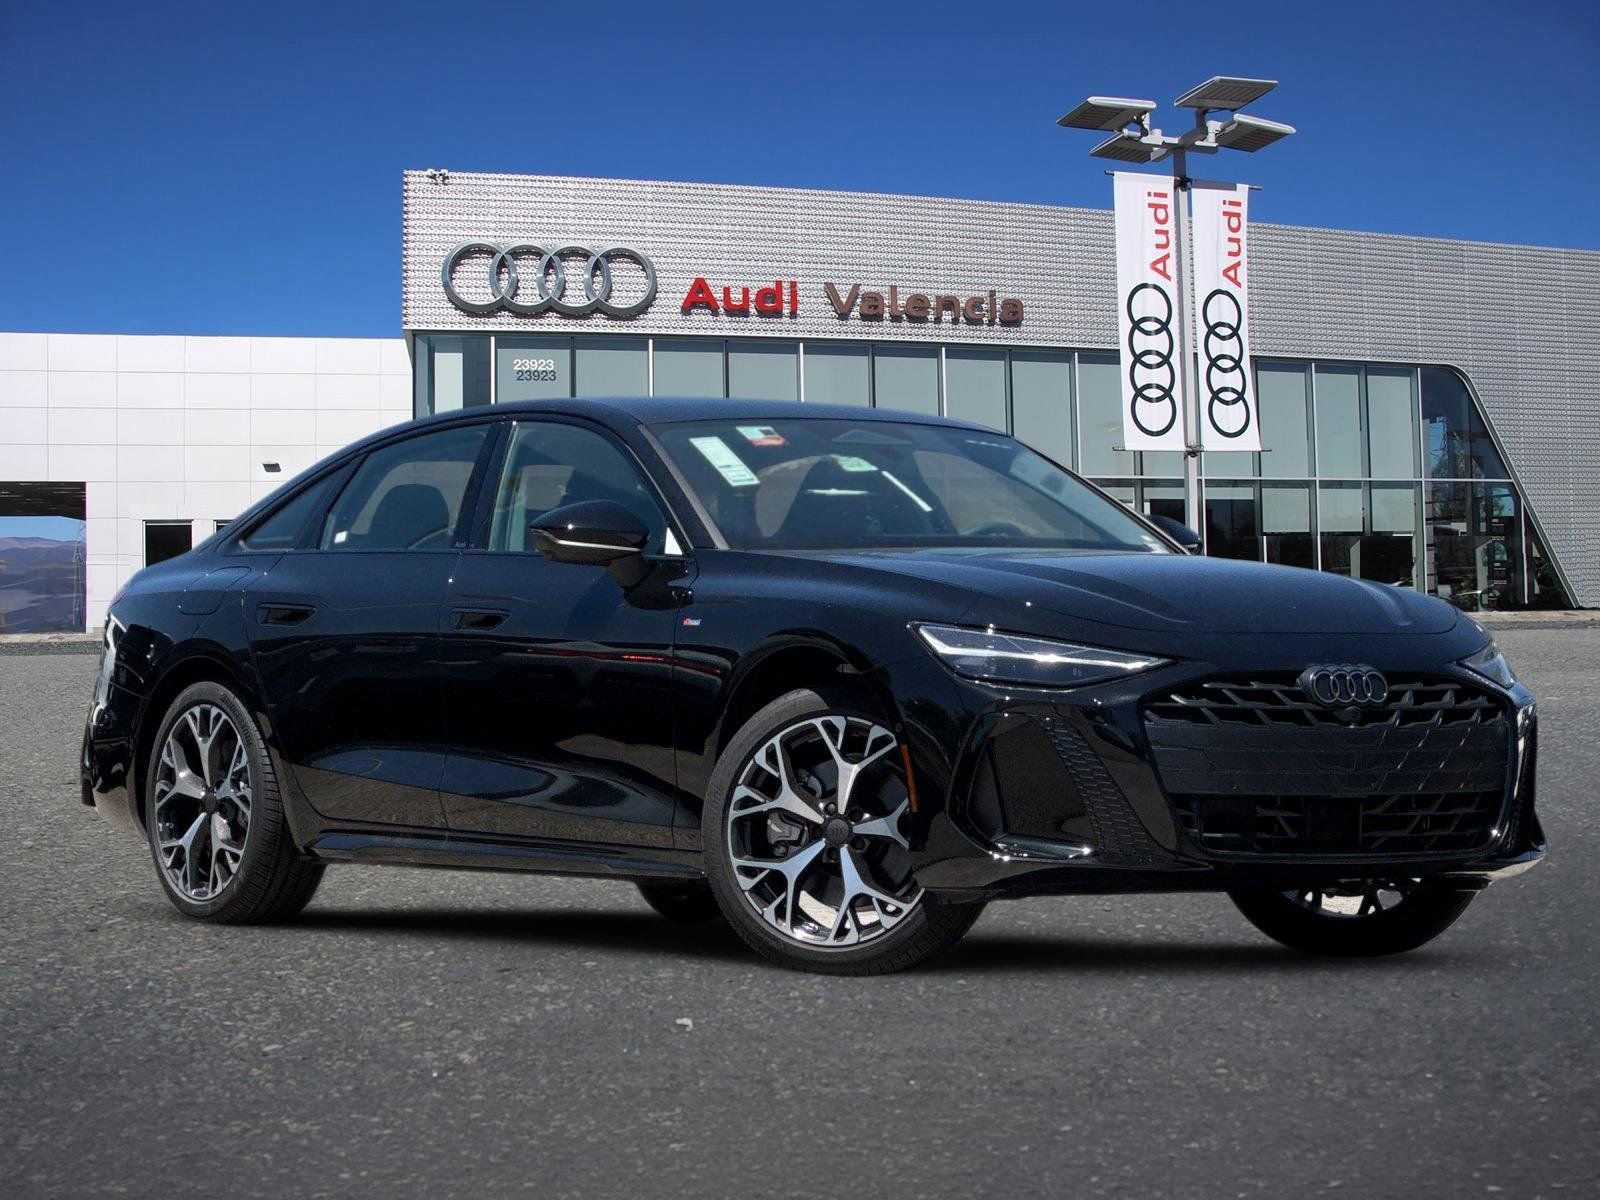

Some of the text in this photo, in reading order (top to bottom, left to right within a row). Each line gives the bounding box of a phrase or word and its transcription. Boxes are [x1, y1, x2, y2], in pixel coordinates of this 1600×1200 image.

[1147, 191, 1172, 281] Audi
[1222, 199, 1242, 289] Audi
[681, 277, 1024, 324] Audi Valencia
[513, 359, 555, 371] 23923
[516, 370, 557, 381] 23923
